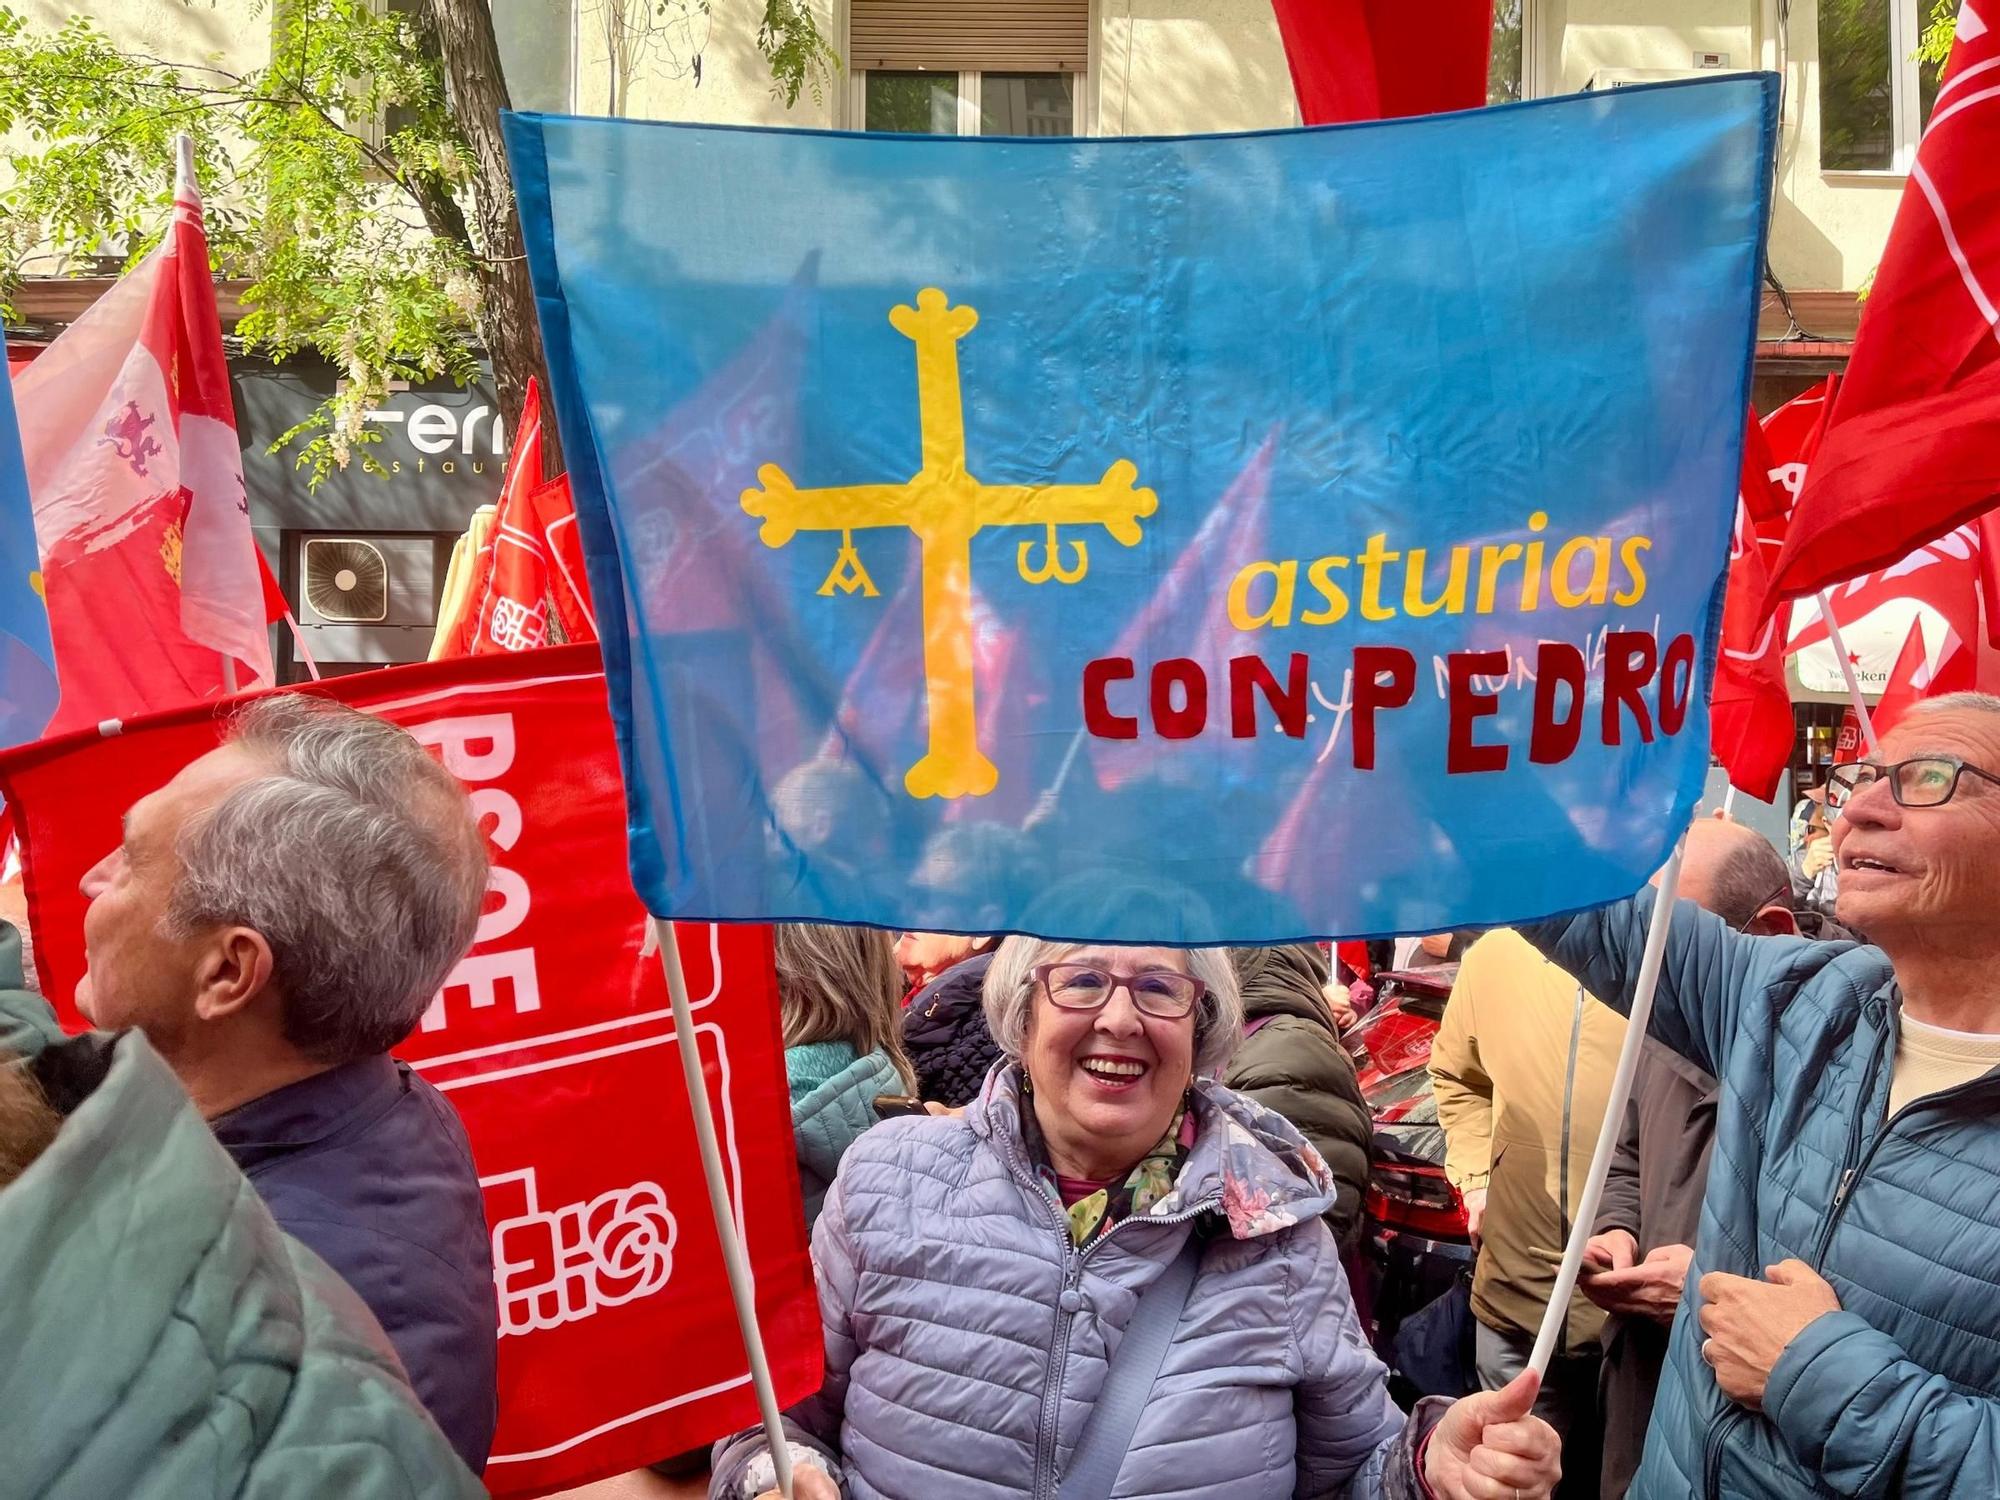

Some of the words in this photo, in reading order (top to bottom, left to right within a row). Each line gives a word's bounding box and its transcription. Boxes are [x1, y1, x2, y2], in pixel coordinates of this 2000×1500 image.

[1228, 511, 1651, 630] asturias
[1083, 653, 1308, 740] CON
[1352, 632, 1695, 773] PEDRO
